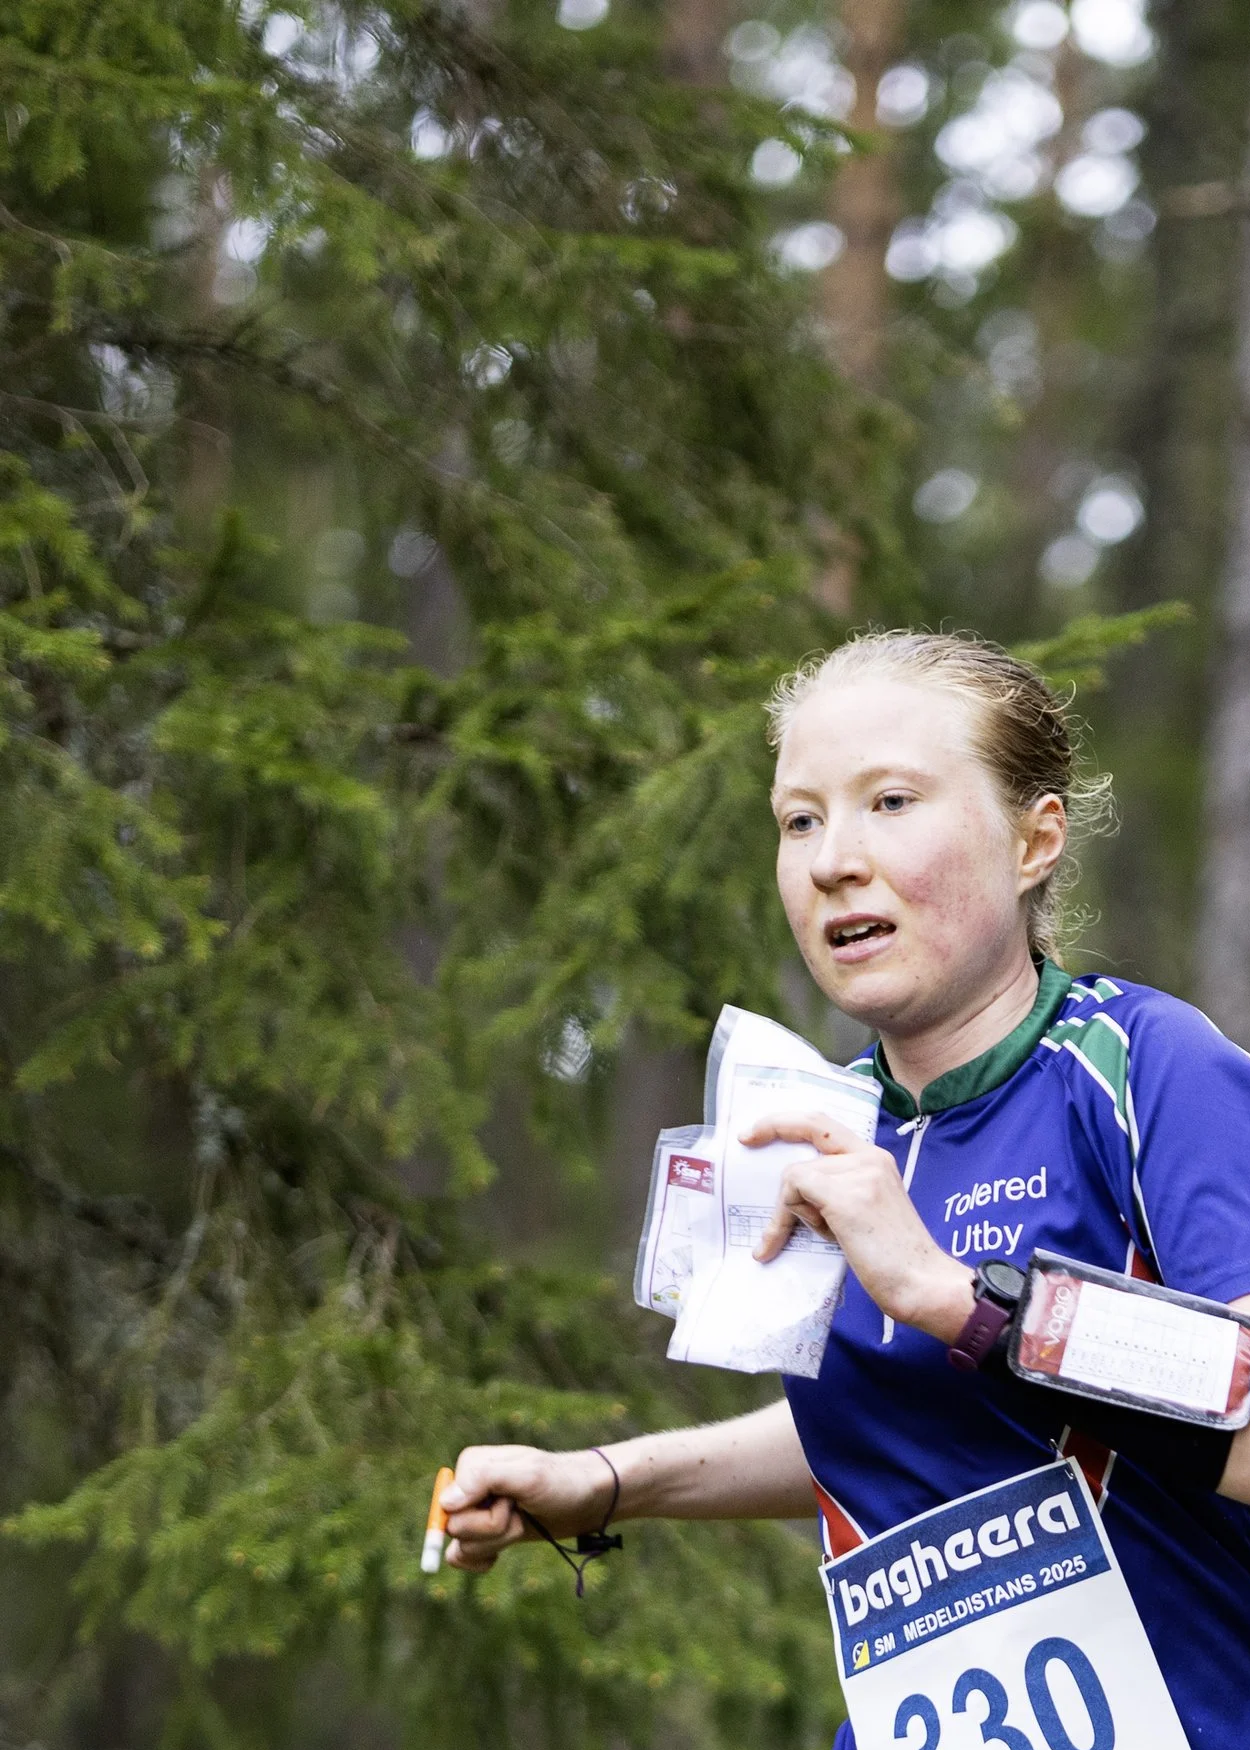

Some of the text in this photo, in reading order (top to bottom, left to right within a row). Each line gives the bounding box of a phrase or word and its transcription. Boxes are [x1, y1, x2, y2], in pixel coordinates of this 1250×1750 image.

[943, 1166, 1047, 1222] Tolered
[951, 1222, 1024, 1258] Utby
[839, 1491, 1081, 1626] bagheera
[874, 1554, 1087, 1657] SM MEDELDISTANS 2025
